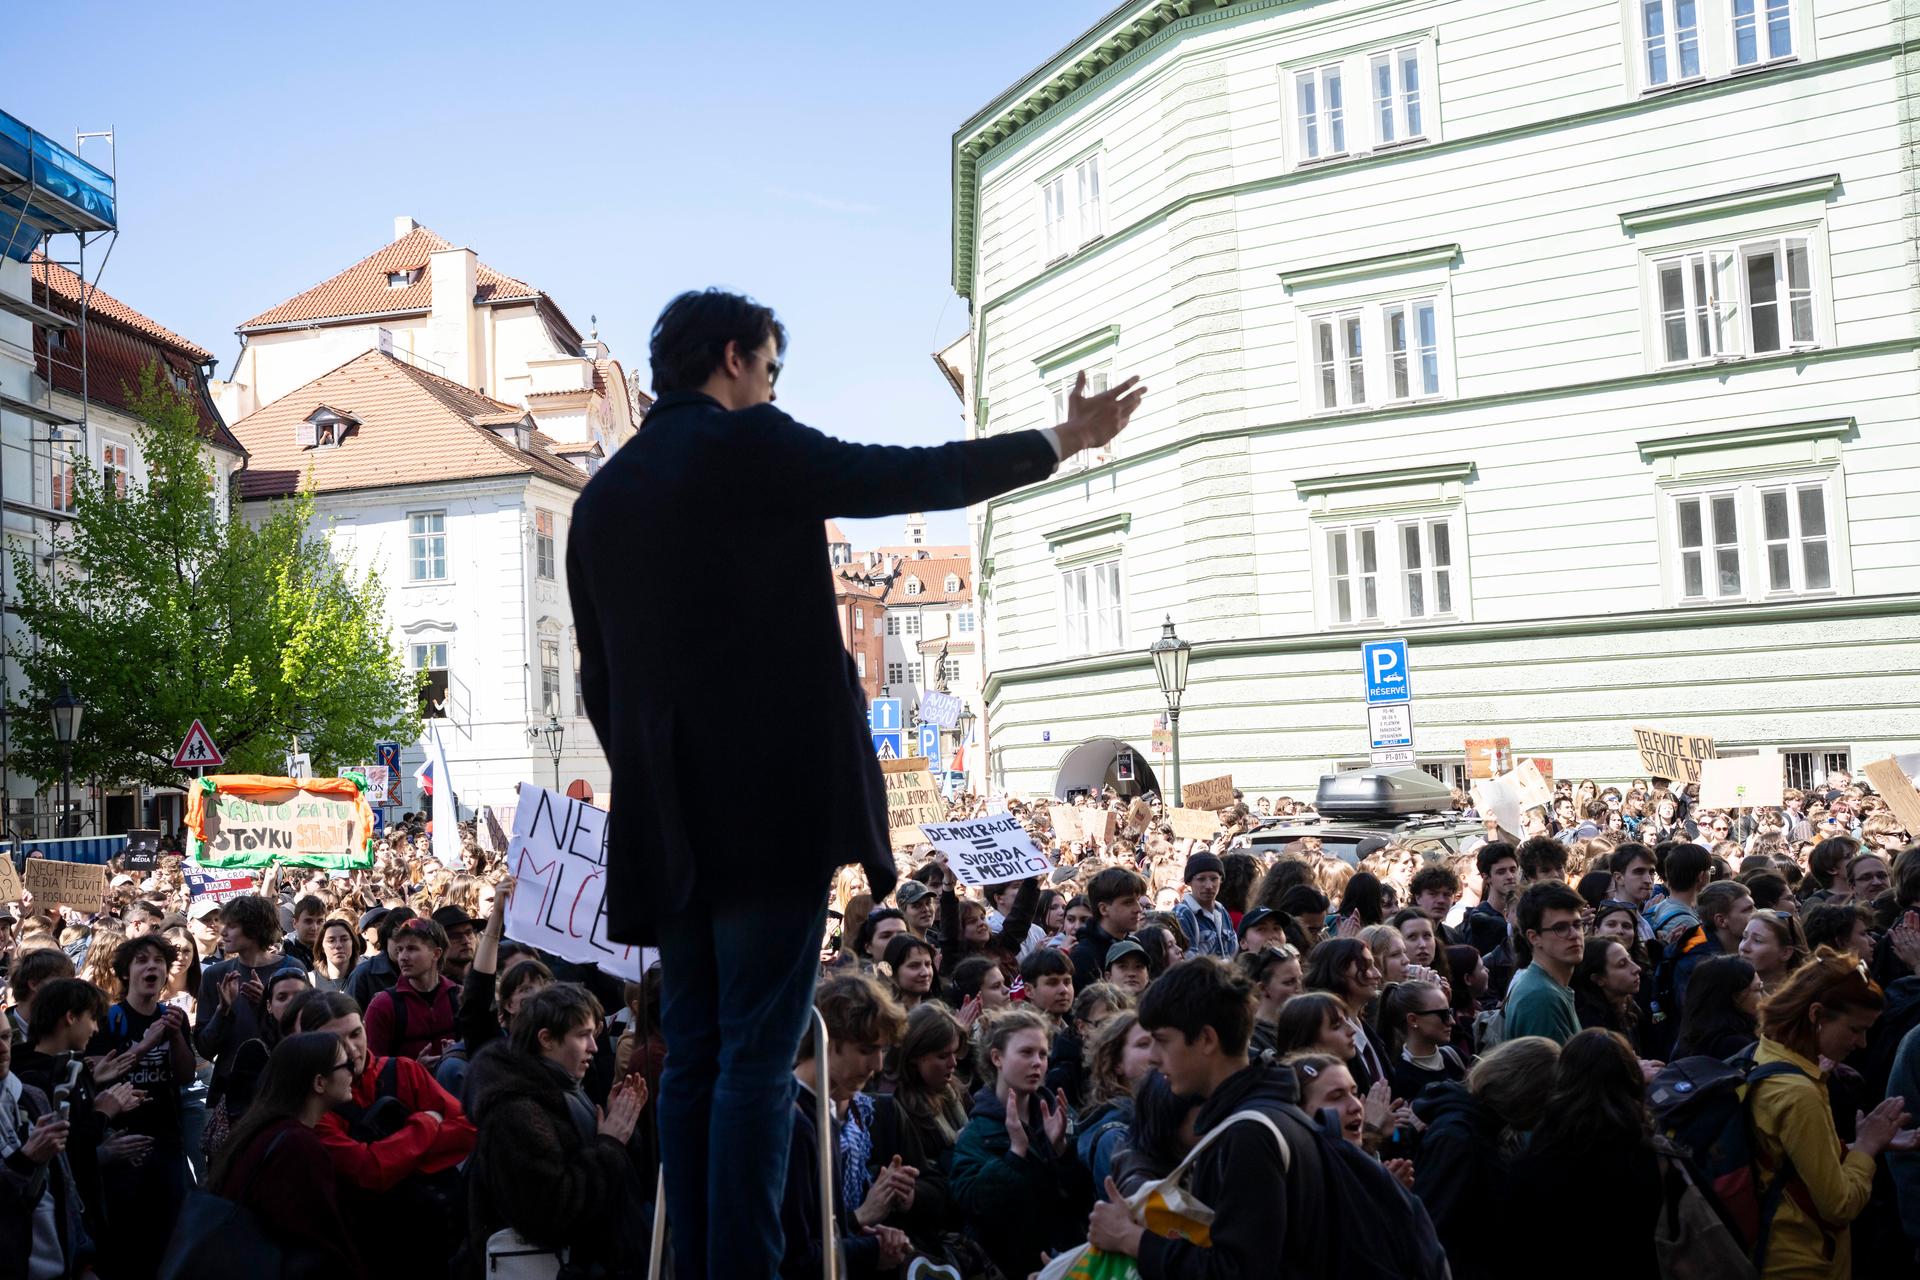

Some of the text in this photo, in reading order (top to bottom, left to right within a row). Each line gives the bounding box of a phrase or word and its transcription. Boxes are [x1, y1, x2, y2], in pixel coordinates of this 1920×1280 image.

[1372, 648, 1398, 684] P
[1370, 685, 1407, 697] RÉSERVÉ
[1633, 729, 1686, 757] TELEVIZE
[215, 827, 293, 851] STOVKU
[925, 817, 1022, 842] DEMOKRACIE
[959, 846, 1027, 866] SVOBODA
[29, 862, 79, 878] NECHTE
[205, 881, 231, 891] JAKO
[510, 847, 634, 962] MLČE
